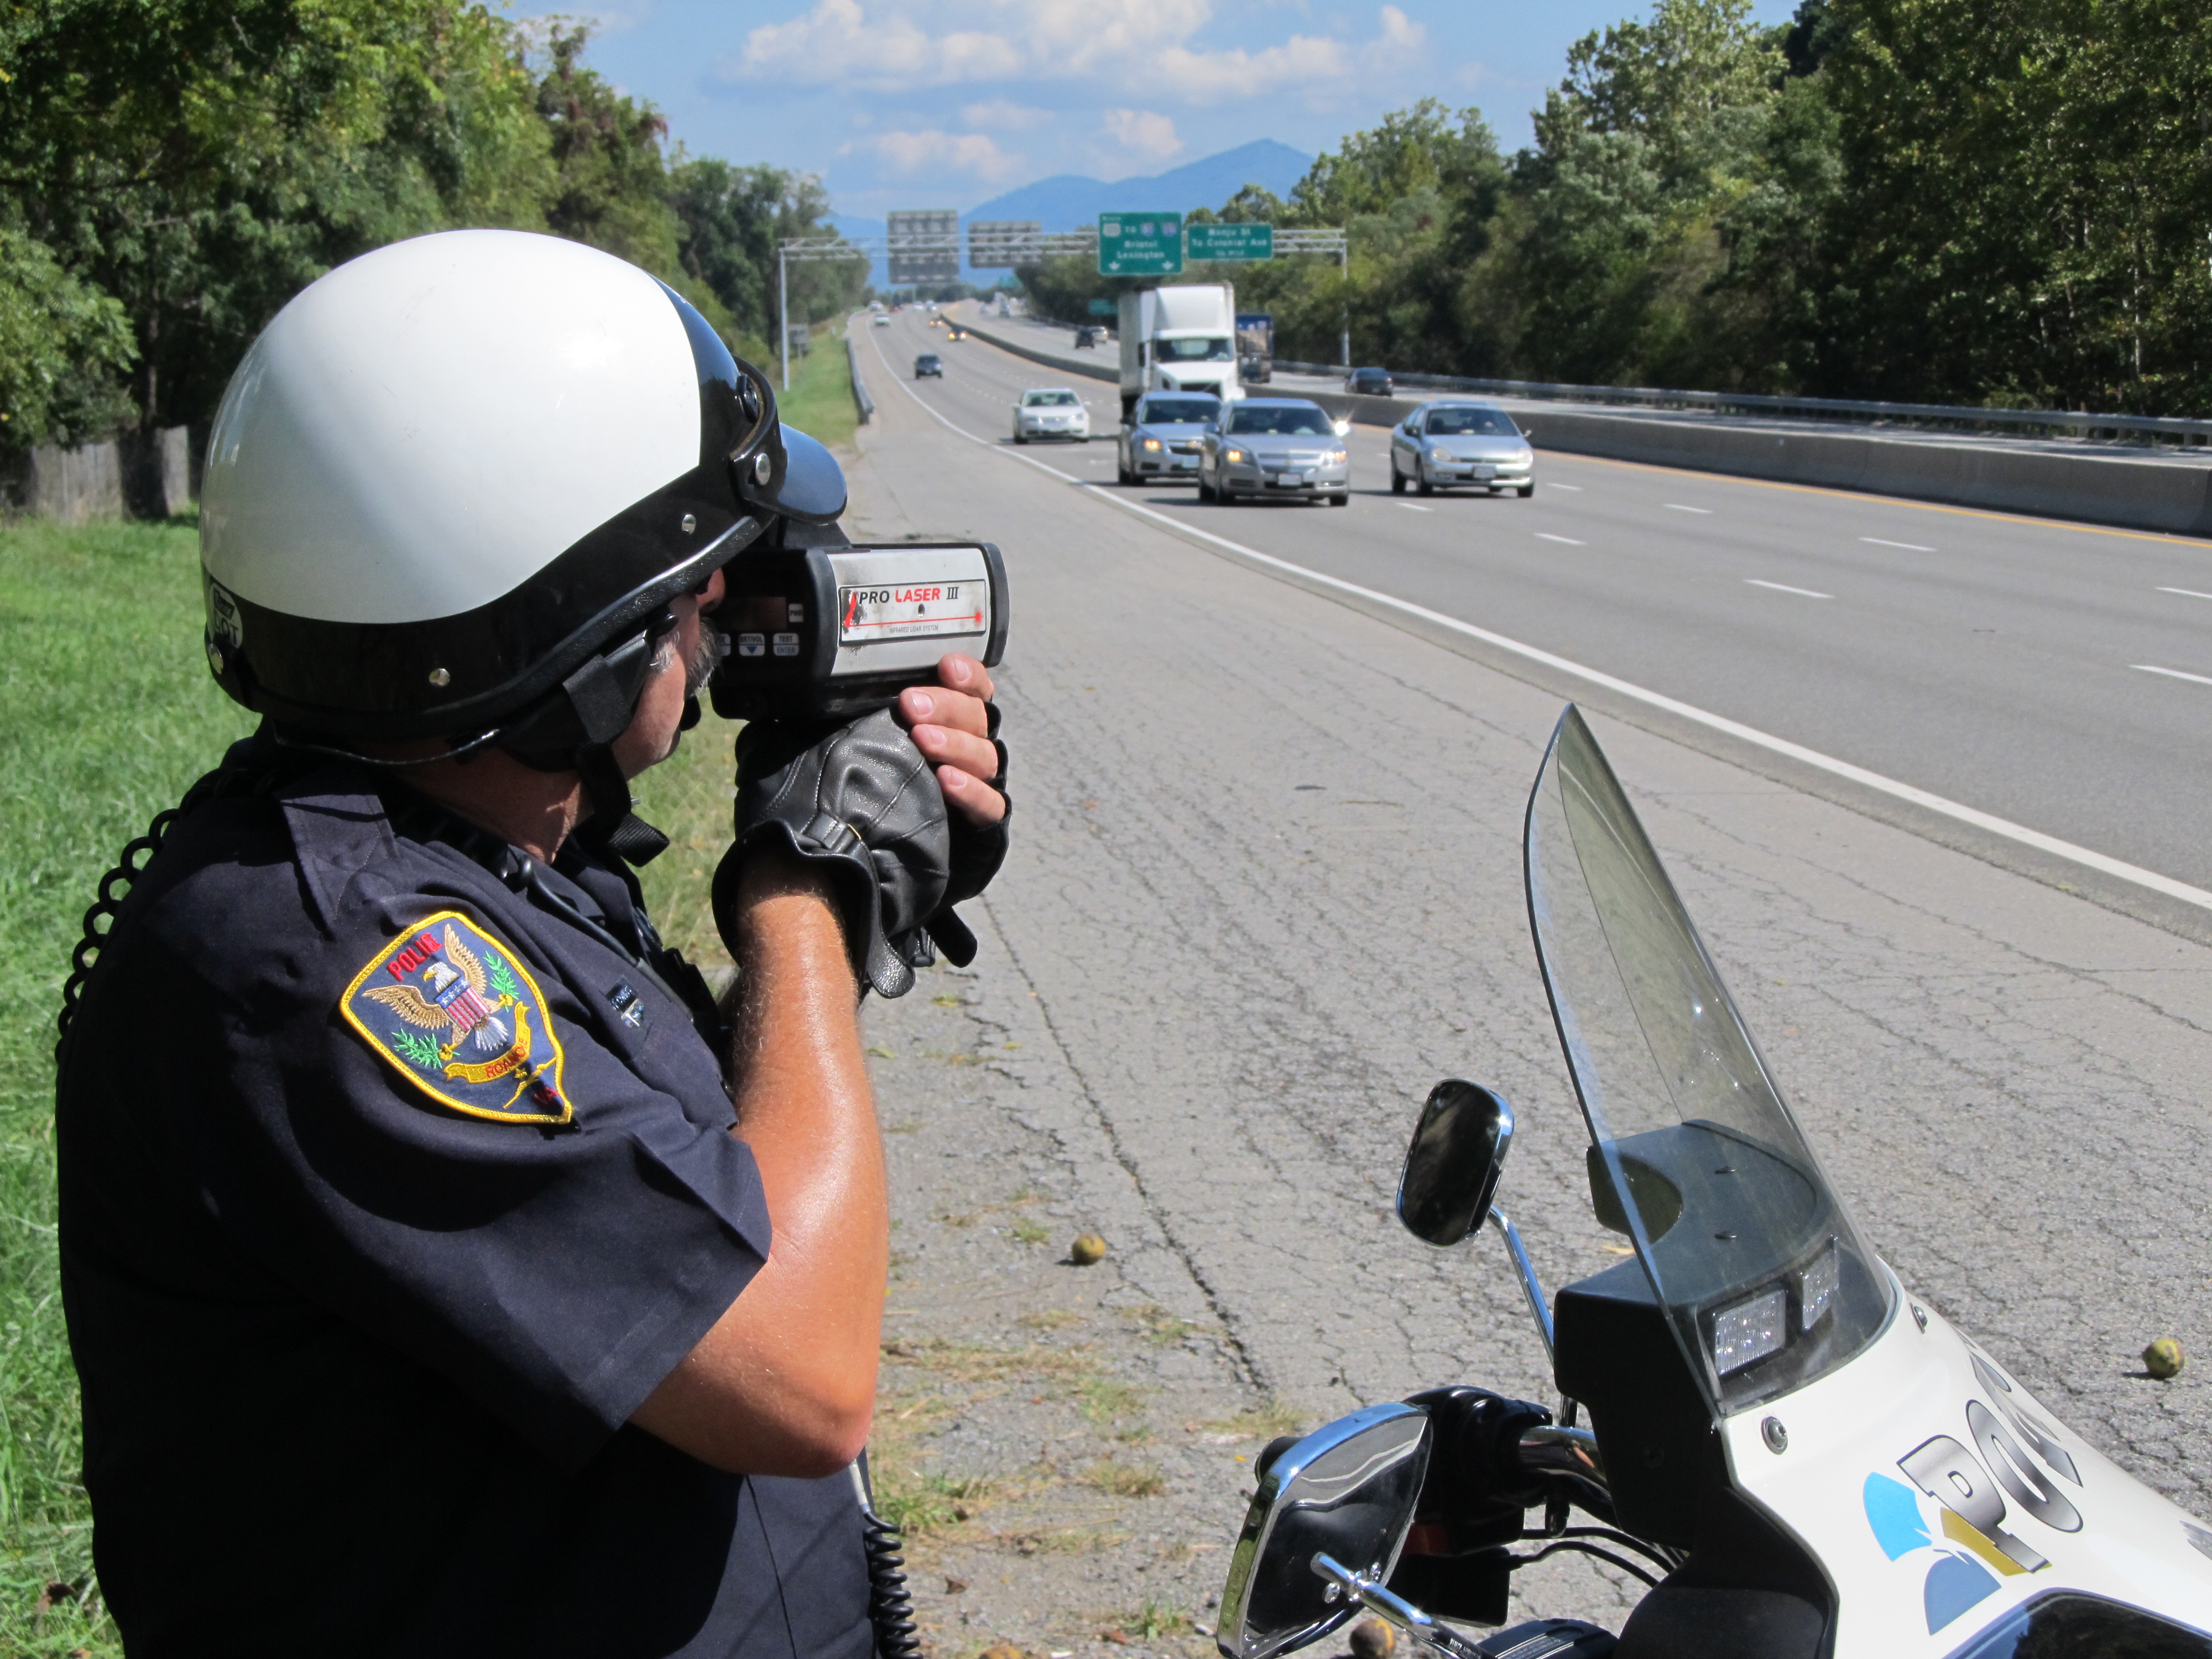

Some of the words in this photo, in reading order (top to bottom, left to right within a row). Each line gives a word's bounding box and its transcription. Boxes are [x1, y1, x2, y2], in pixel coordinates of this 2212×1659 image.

[1117, 251, 1165, 260] Lexington
[859, 591, 890, 604] PRO
[895, 587, 941, 603] LASER
[946, 586, 959, 600] III
[386, 932, 443, 982] POLICE
